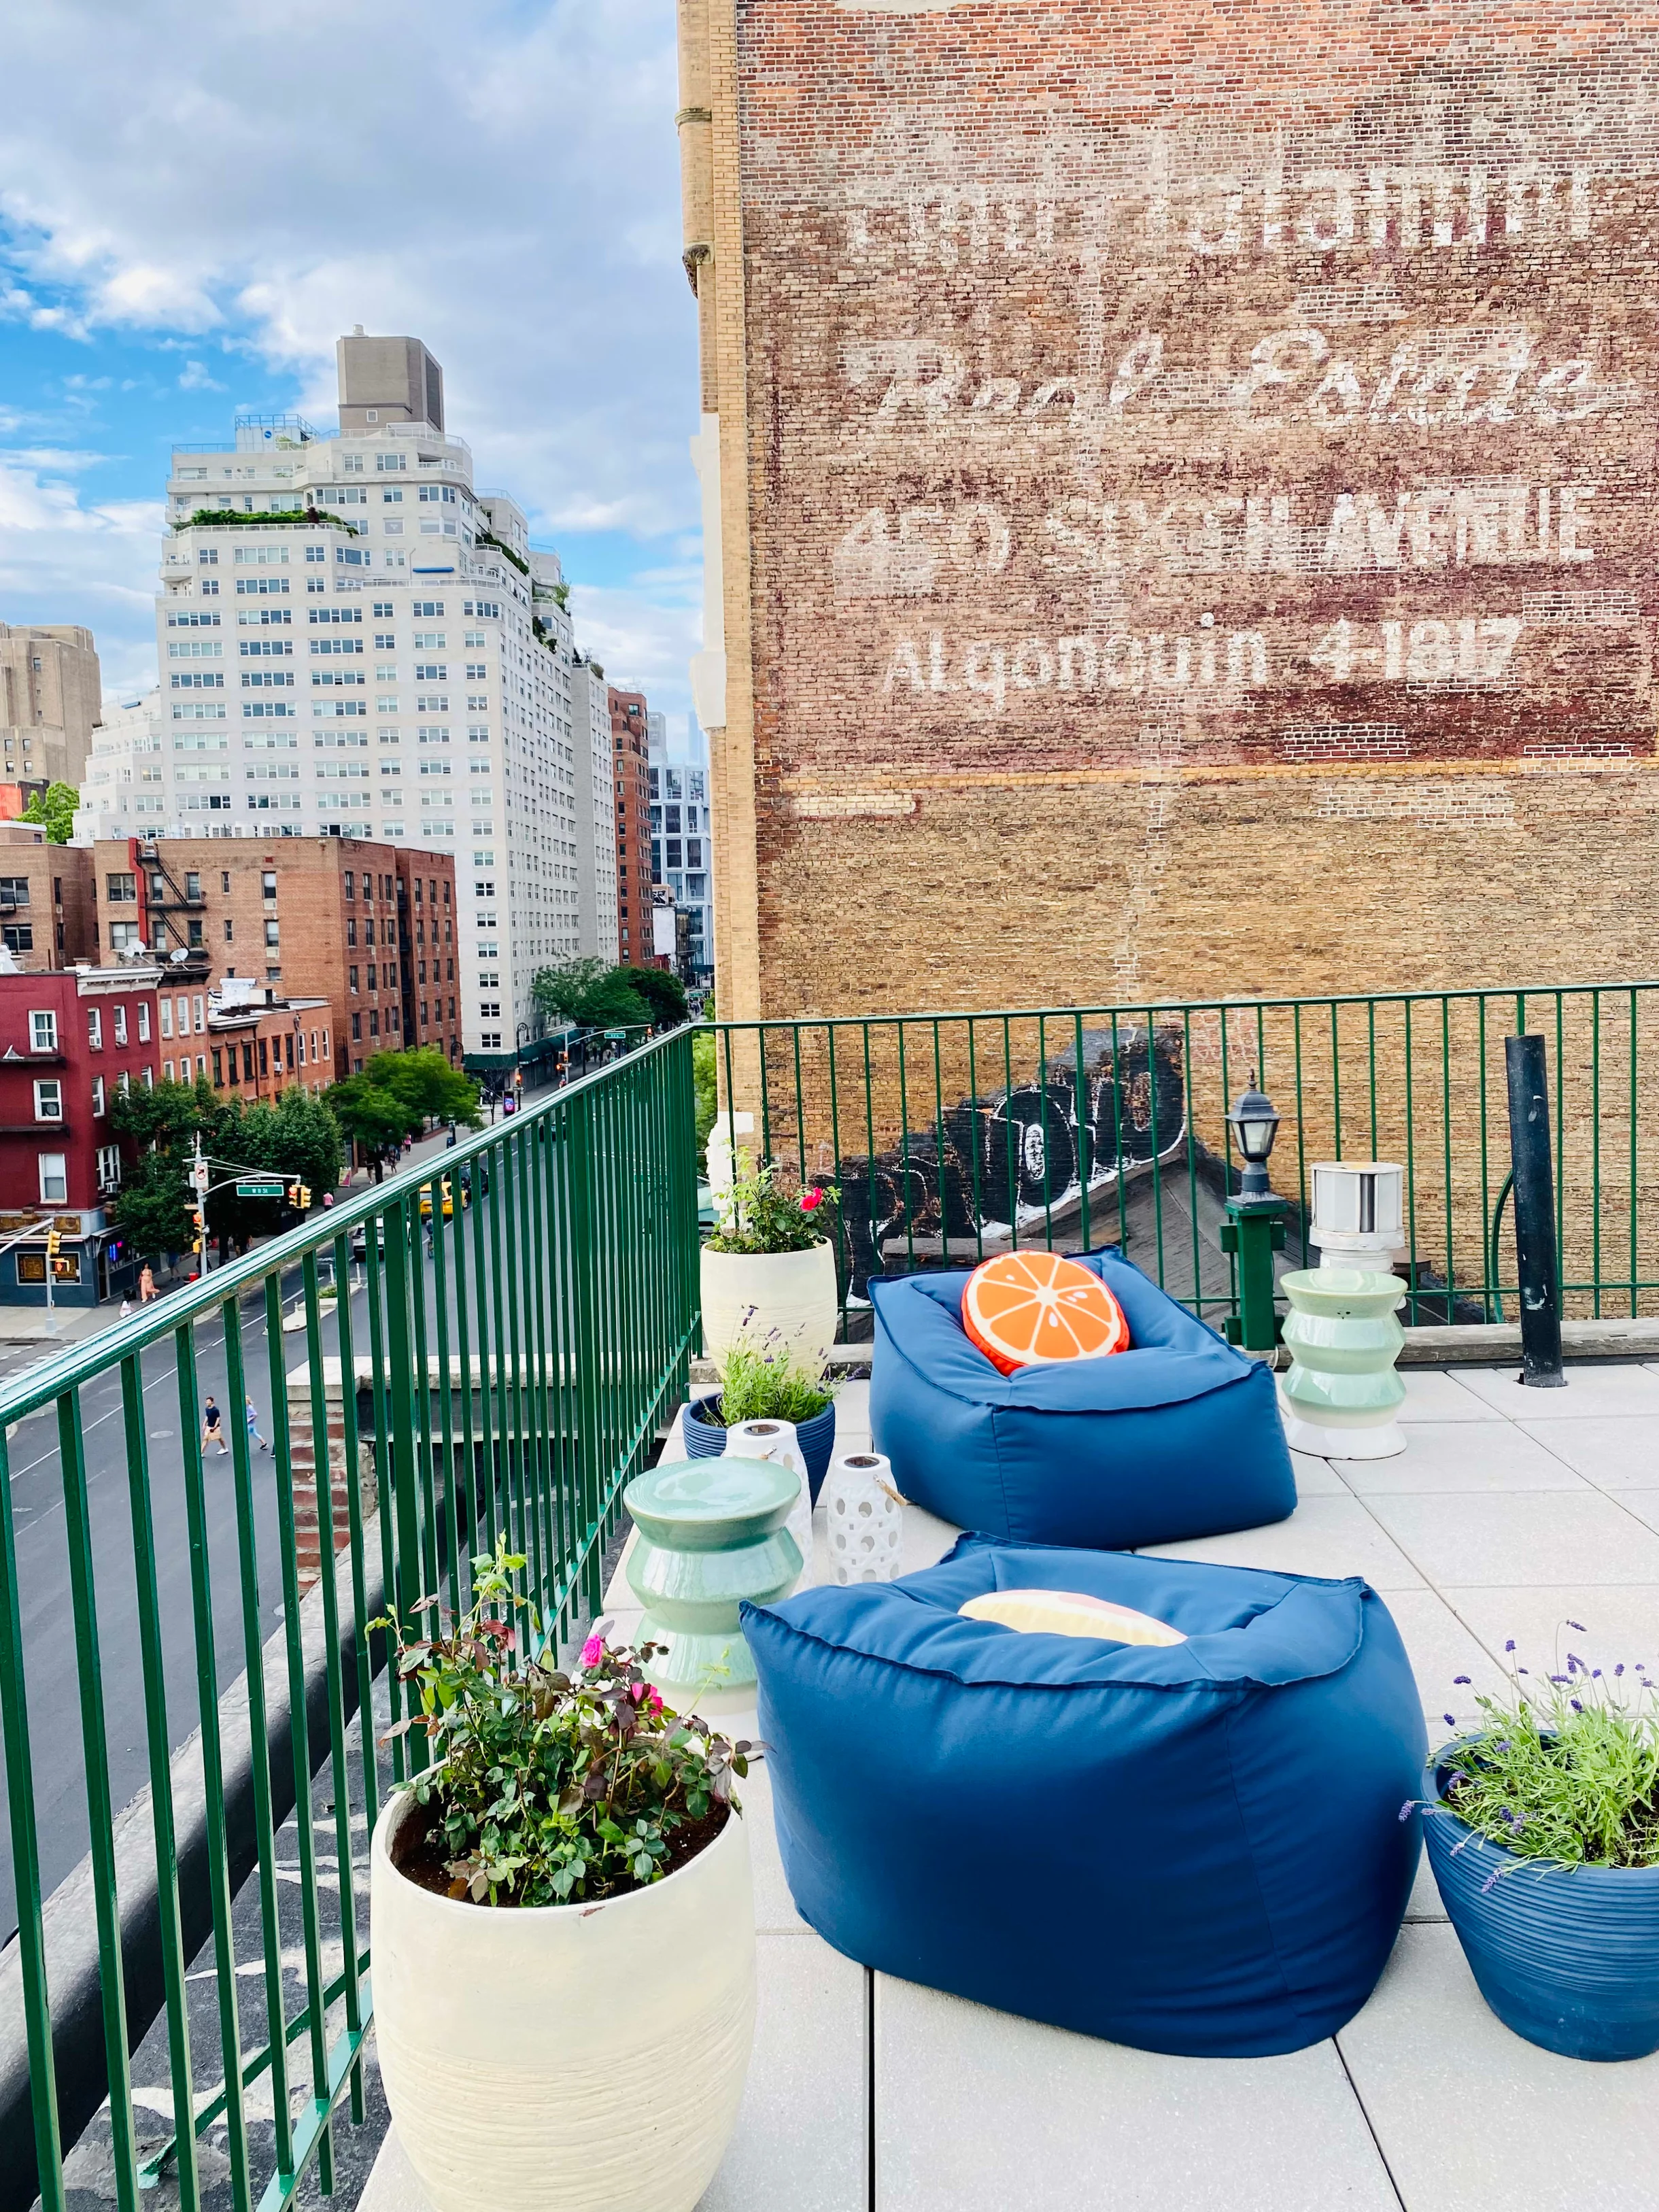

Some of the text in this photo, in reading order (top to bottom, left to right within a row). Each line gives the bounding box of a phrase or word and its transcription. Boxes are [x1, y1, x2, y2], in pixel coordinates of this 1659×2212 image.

[1246, 326, 1599, 428] Estate
[1322, 486, 1596, 568] AVENUE
[1308, 617, 1523, 680] 4-1817
